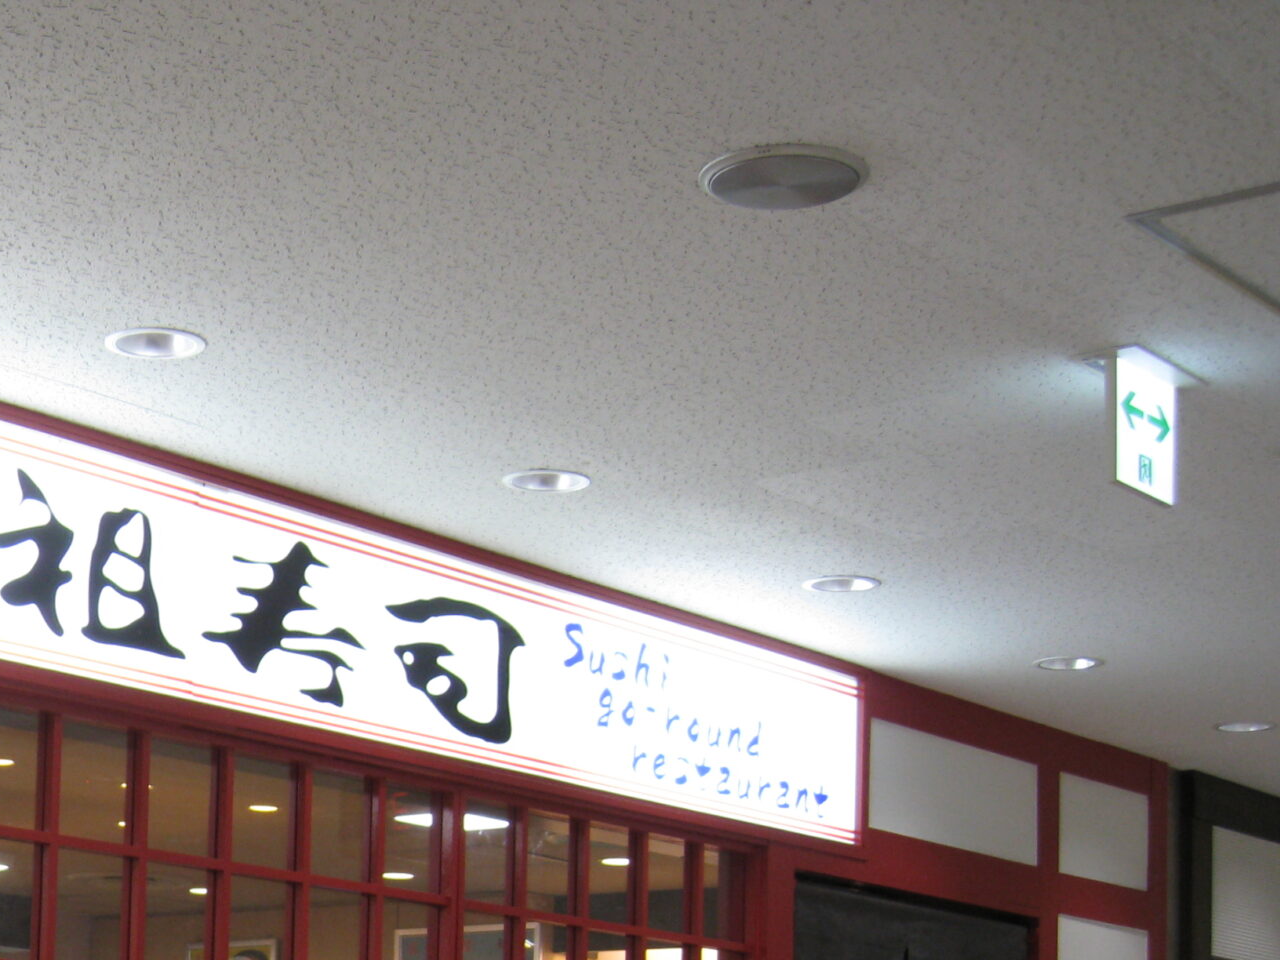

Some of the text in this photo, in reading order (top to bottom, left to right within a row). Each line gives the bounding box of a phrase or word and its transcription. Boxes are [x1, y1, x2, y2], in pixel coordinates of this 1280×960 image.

[563, 622, 670, 689] Sushi
[596, 687, 762, 757] go-round
[631, 744, 829, 818] restaurant
